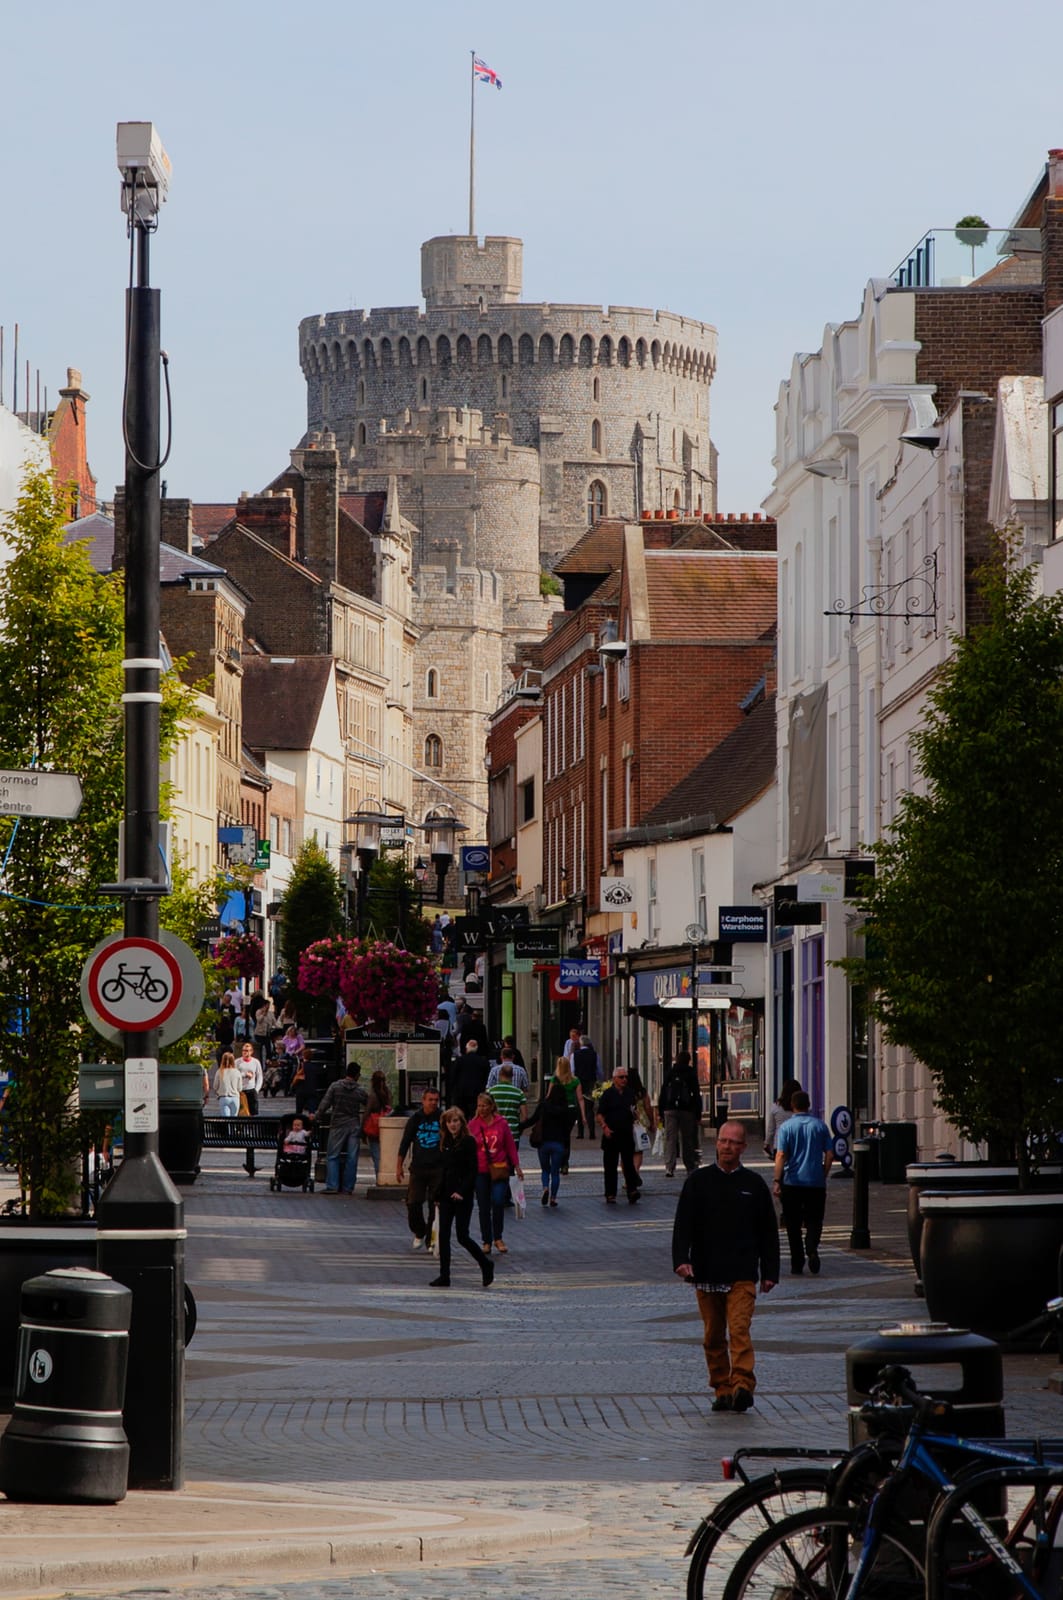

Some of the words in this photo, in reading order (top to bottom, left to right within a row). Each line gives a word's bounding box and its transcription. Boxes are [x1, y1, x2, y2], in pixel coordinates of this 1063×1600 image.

[463, 932, 480, 945] W
[561, 969, 599, 977] HALIFAX
[653, 973, 678, 999] CORAL
